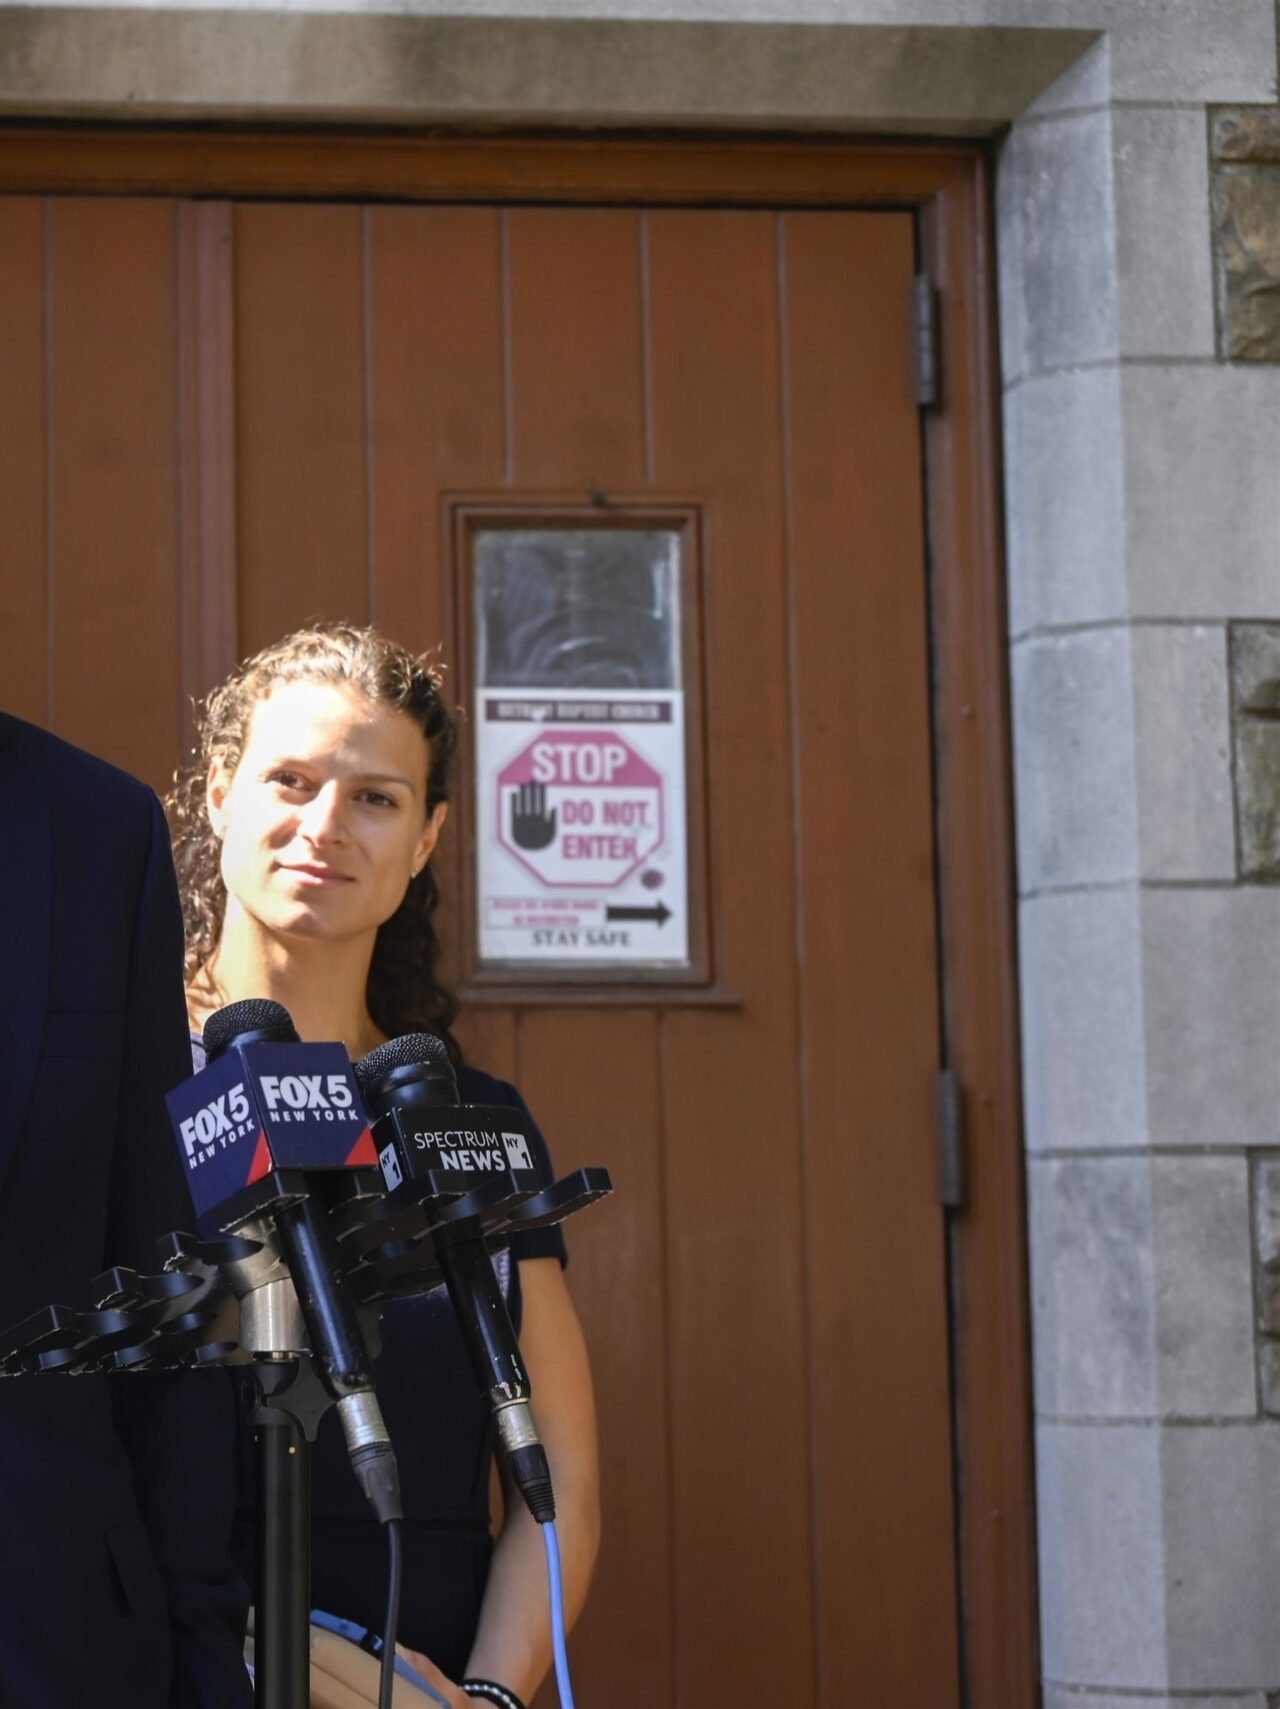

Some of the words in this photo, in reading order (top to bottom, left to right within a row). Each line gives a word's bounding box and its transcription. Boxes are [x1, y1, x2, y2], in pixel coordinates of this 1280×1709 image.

[532, 742, 628, 783] STOP
[562, 799, 595, 825] DO
[603, 801, 650, 826] NOT
[562, 835, 638, 860] ENTER
[532, 930, 580, 946] STAY
[585, 930, 631, 946] SAFE
[270, 1110, 306, 1122] NEW
[313, 1109, 359, 1121] YORK
[188, 1145, 216, 1170] NEW
[220, 1119, 255, 1148] YORK
[414, 1131, 499, 1149] SPECTRUM
[505, 1137, 521, 1149] NY
[381, 1151, 391, 1167] NY
[440, 1150, 506, 1171] NEWS
[521, 1151, 532, 1169] 1
[392, 1161, 400, 1180] 1
